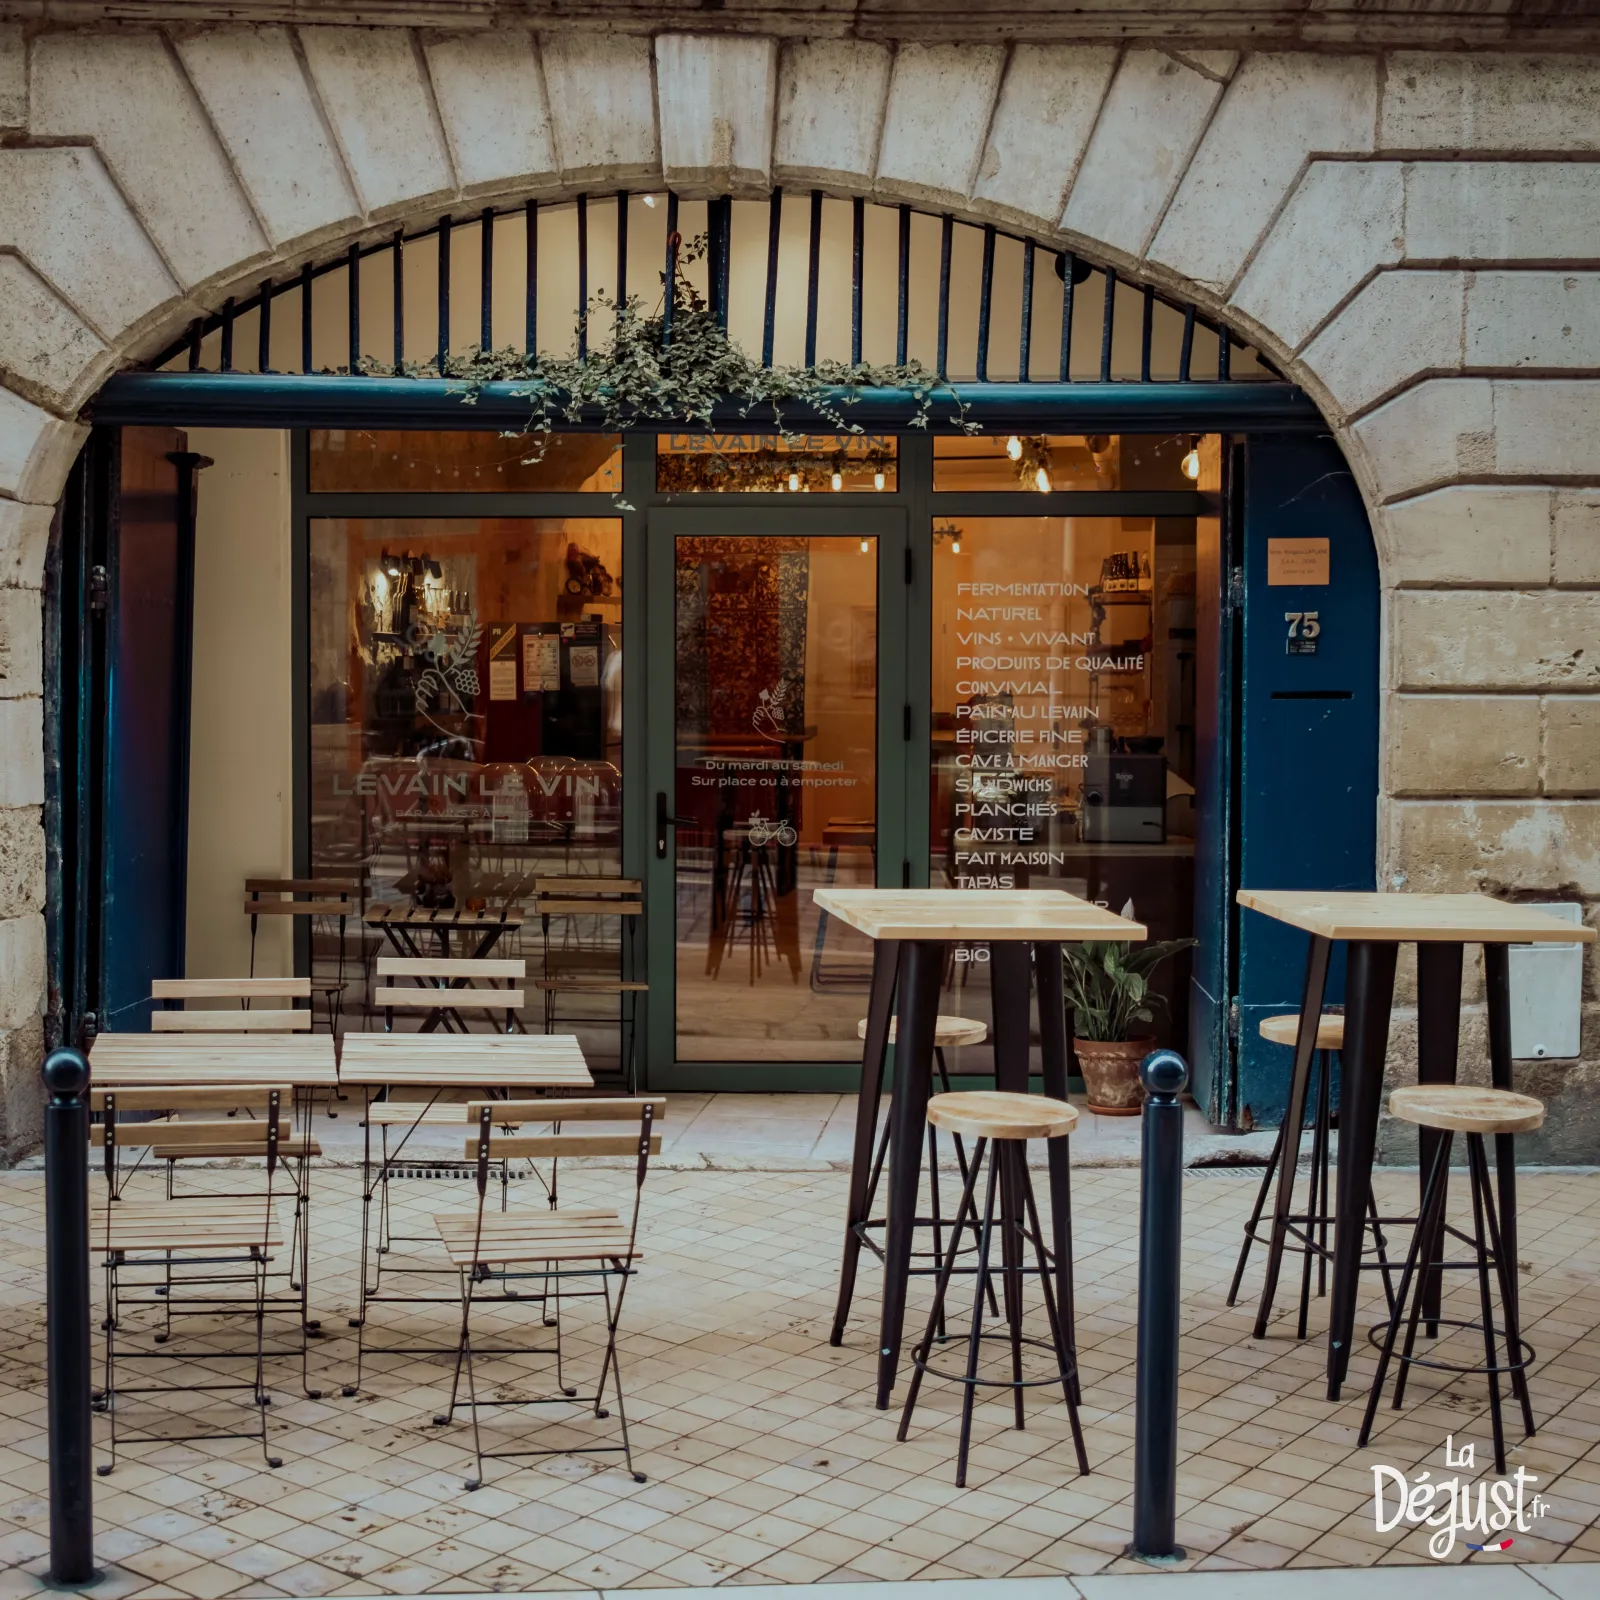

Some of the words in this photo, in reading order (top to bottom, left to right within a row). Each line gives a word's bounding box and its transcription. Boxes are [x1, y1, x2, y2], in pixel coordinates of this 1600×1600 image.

[671, 434, 777, 451] LEVAIN
[836, 434, 886, 450] VIN
[957, 583, 1089, 597] FERMENTATION
[956, 607, 1042, 621] NATUREL
[1284, 611, 1321, 638] 75
[956, 632, 1001, 645] VINS
[1020, 632, 1096, 645] VIVANT
[956, 656, 1041, 670] PRODUITS
[1046, 656, 1070, 670] DE
[1075, 654, 1144, 672] QUALITÉ
[956, 681, 1063, 695] CONVIVIAL
[956, 705, 1007, 719] PAIN
[1011, 705, 1036, 719] AU
[1041, 705, 1099, 719] LEVAIN
[956, 728, 1034, 743] ÉPICERIE
[1039, 730, 1082, 743] FINE
[705, 761, 725, 771] Du
[728, 760, 768, 771] mardi
[772, 762, 789, 771] au
[792, 760, 844, 771] samedi
[955, 754, 1001, 768] CAVE
[1005, 752, 1014, 768] À
[1019, 754, 1088, 768] MANGER
[333, 774, 467, 796] LEVAIN
[480, 774, 524, 796] LE
[537, 775, 600, 797] VIN
[691, 776, 716, 786] Sur
[719, 775, 757, 788] place
[759, 777, 777, 786] ou
[780, 775, 788, 786] à
[792, 776, 858, 788] emporter
[955, 778, 1053, 793] SANDWICHS
[955, 803, 1058, 817] PLANCHES
[954, 827, 1034, 841] CAVISTE
[954, 851, 996, 865] FAIT
[1000, 851, 1064, 865] MAISON
[954, 876, 1014, 889] TAPAS
[954, 948, 990, 962] BIO
